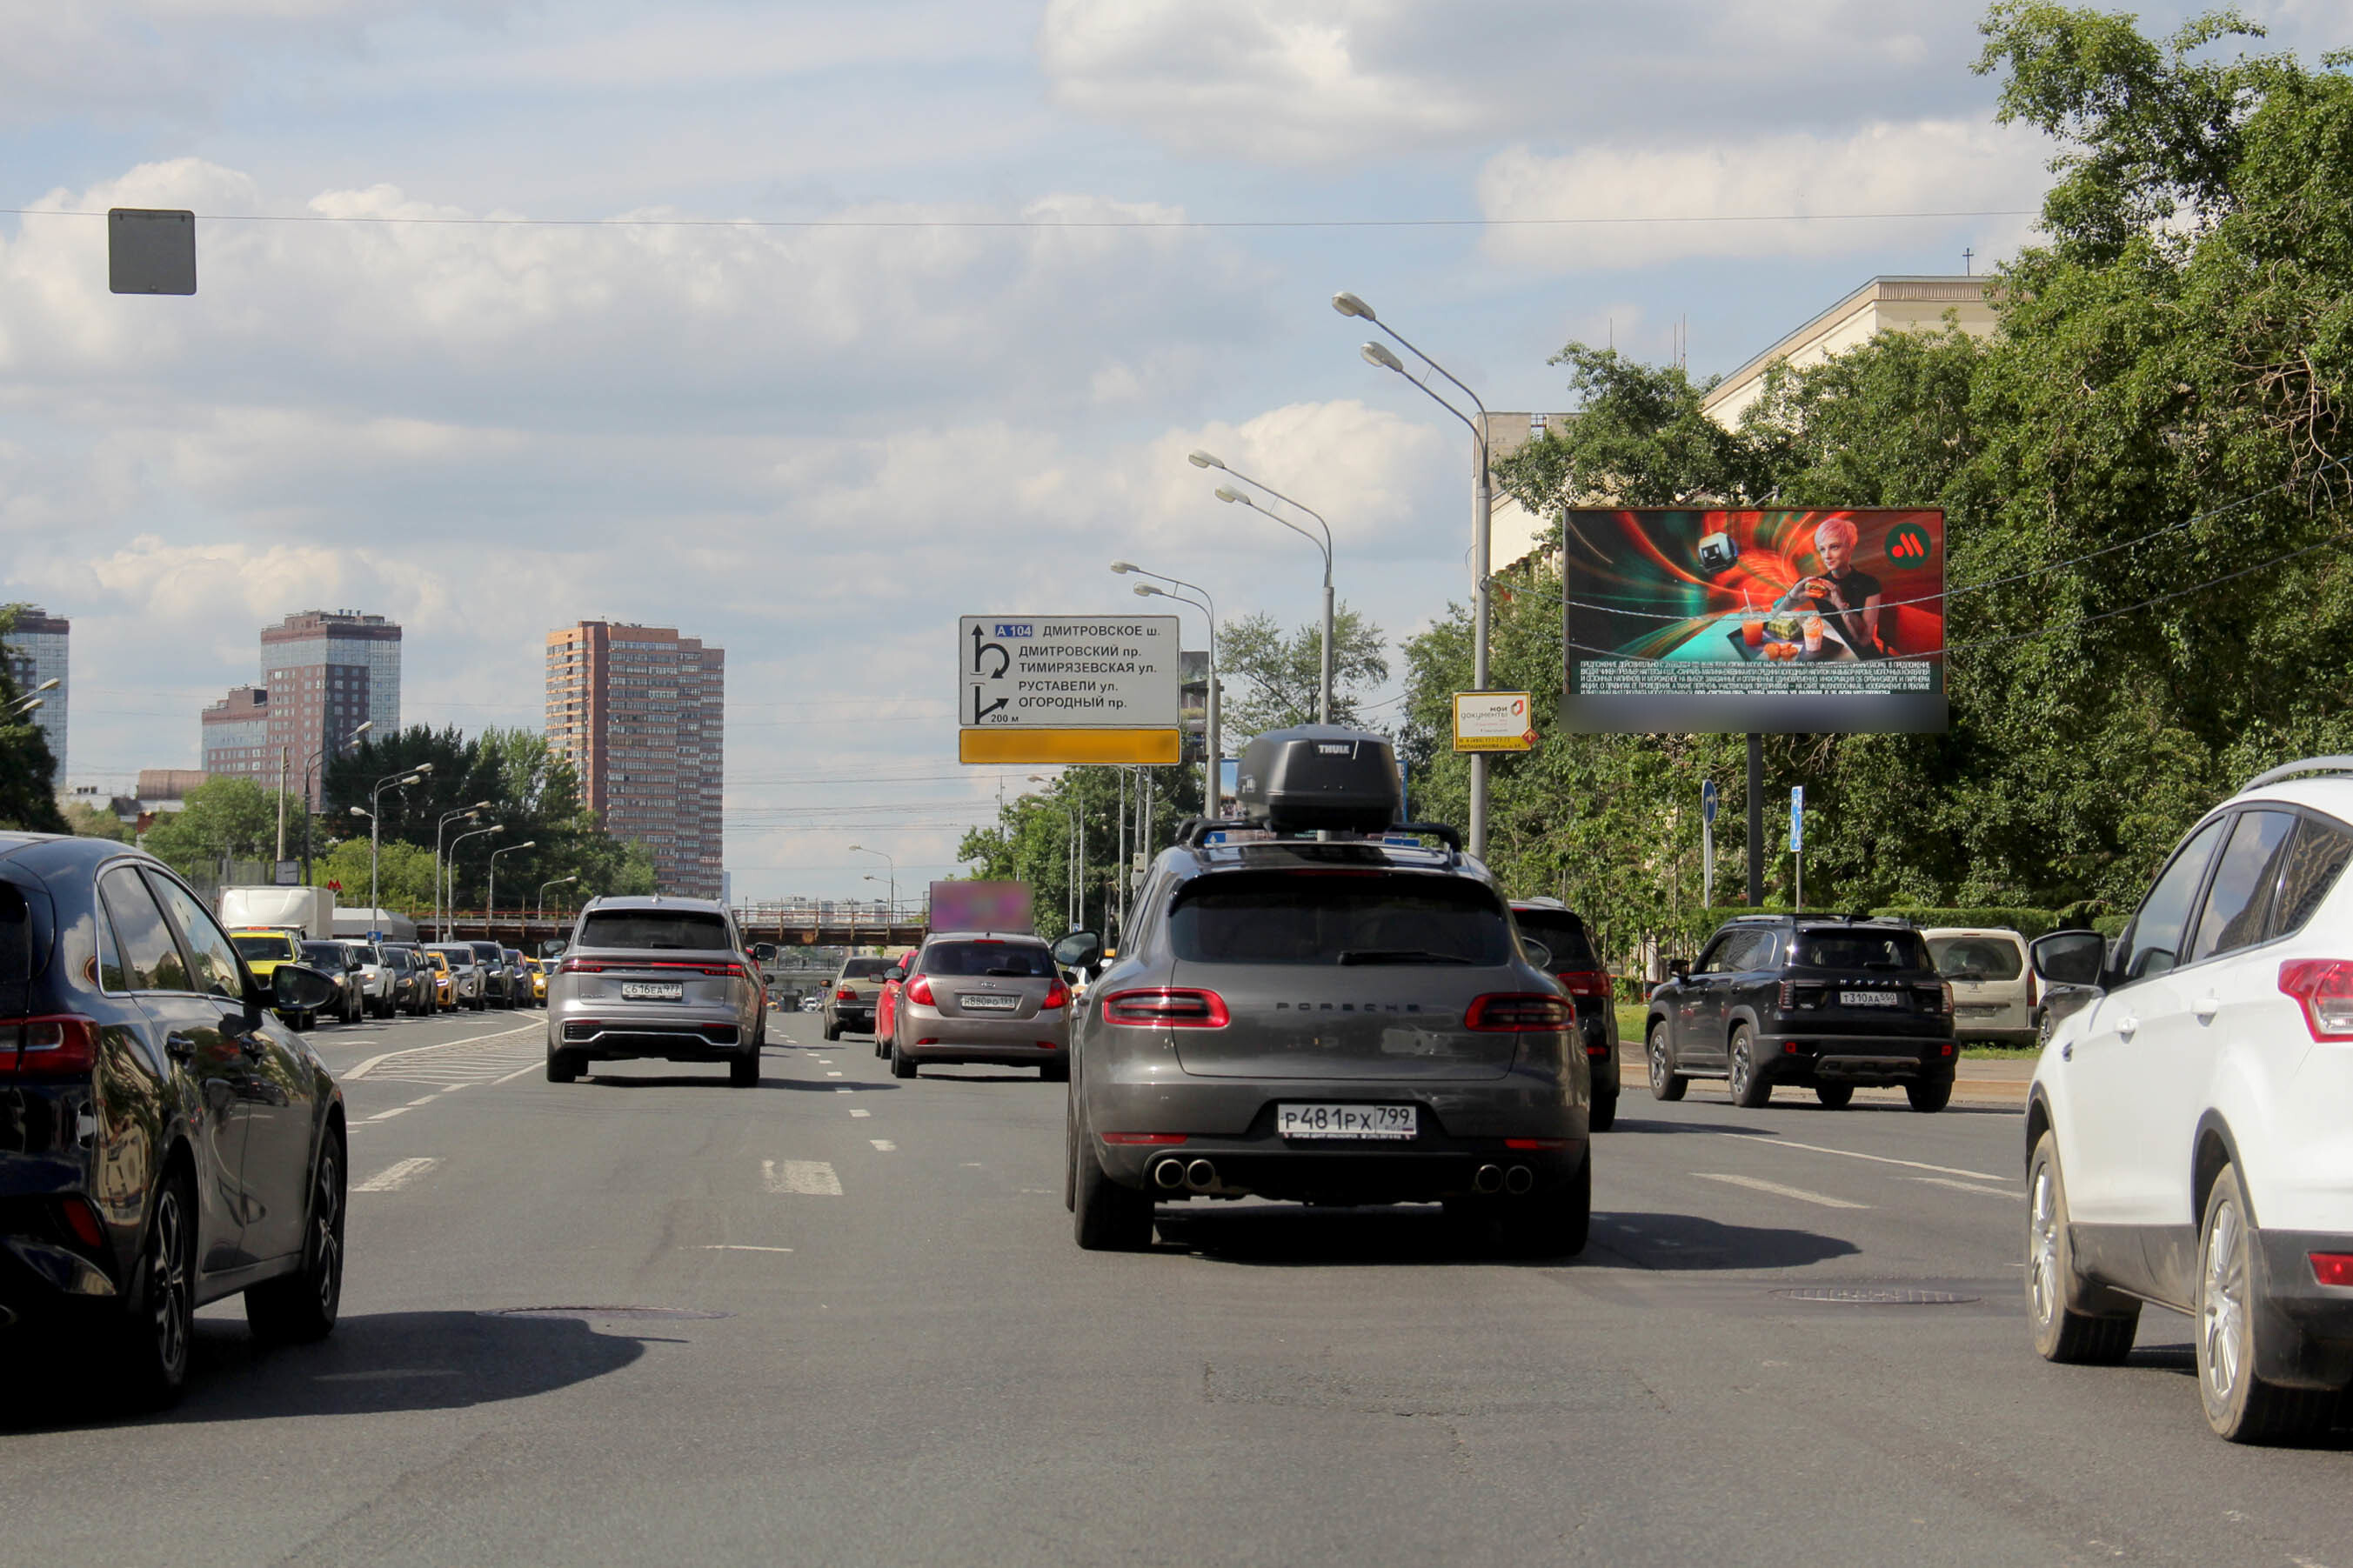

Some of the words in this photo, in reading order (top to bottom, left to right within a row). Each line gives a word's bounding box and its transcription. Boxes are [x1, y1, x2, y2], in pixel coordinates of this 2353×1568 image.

[1010, 626, 1032, 637] 104
[1043, 625, 1142, 637] ДМИТРОВСКОЕ
[1146, 628, 1160, 637] ш.
[1019, 644, 1119, 657] ДМИТРОВСКИЙ
[1123, 649, 1141, 658] пр.
[1019, 663, 1134, 673] ТИМИРЯЗЕВСКАЯ
[1138, 664, 1157, 675] ул.
[1019, 681, 1096, 691] РУСТАВЕЛИ
[1100, 684, 1118, 693] ул.
[1019, 696, 1104, 709] ОГОРОДНЫЙ
[1108, 700, 1126, 710] пр.
[991, 714, 1008, 723] 200
[1318, 744, 1350, 754] THULE
[1276, 1002, 1420, 1011] PORSCHE
[1376, 1107, 1410, 1124] 799
